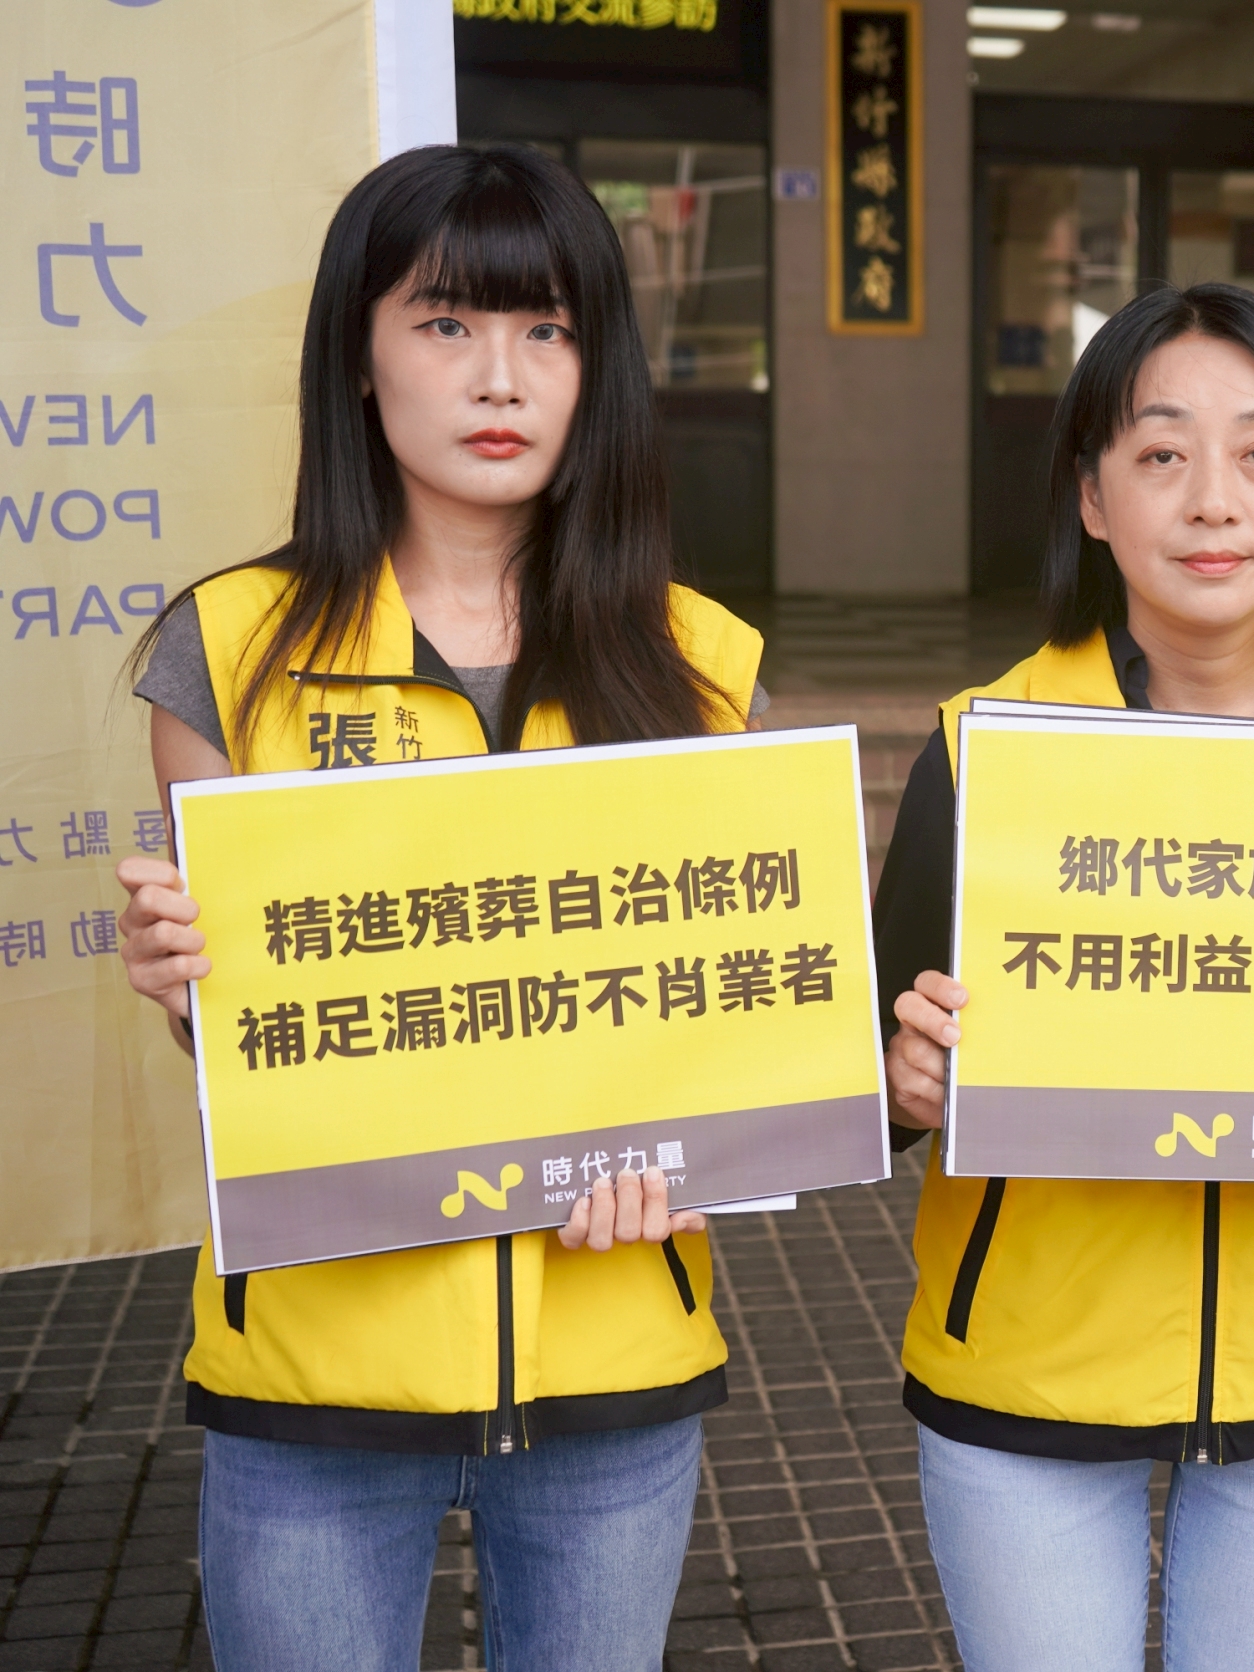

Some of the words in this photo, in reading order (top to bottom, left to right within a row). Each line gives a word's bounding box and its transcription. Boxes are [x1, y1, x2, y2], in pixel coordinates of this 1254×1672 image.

[309, 712, 377, 770] 張
[394, 705, 423, 760] 新竹
[263, 848, 801, 965] 精進殯葬自治條例
[237, 943, 838, 1071] 補足漏洞防不肖業者
[542, 1140, 686, 1187] 時代力量
[544, 1189, 578, 1204] NEW
